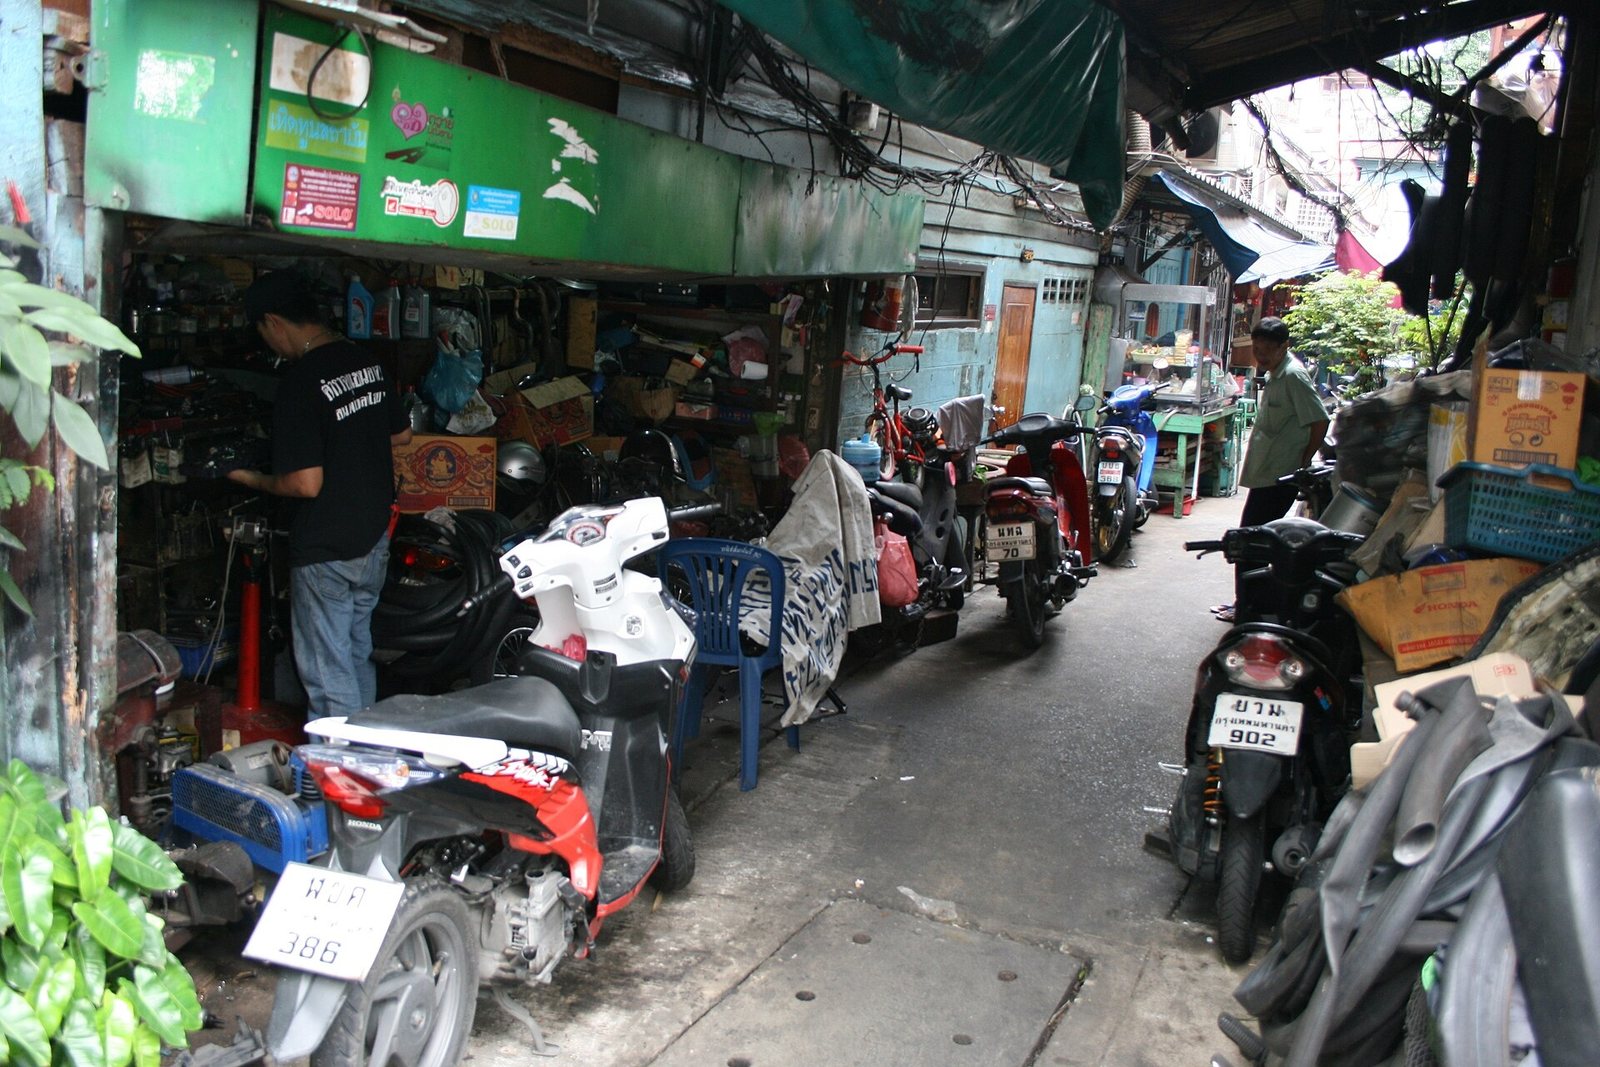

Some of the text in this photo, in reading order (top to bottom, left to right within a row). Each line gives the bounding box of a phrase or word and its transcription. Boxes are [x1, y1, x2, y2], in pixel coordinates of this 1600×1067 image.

[313, 204, 353, 222] SOLO
[481, 217, 515, 233] SOLO
[1003, 547, 1019, 559] 70
[1428, 600, 1478, 612] HONDA
[1230, 729, 1276, 747] 902
[348, 819, 382, 831] HONDA
[279, 931, 341, 964] 386
